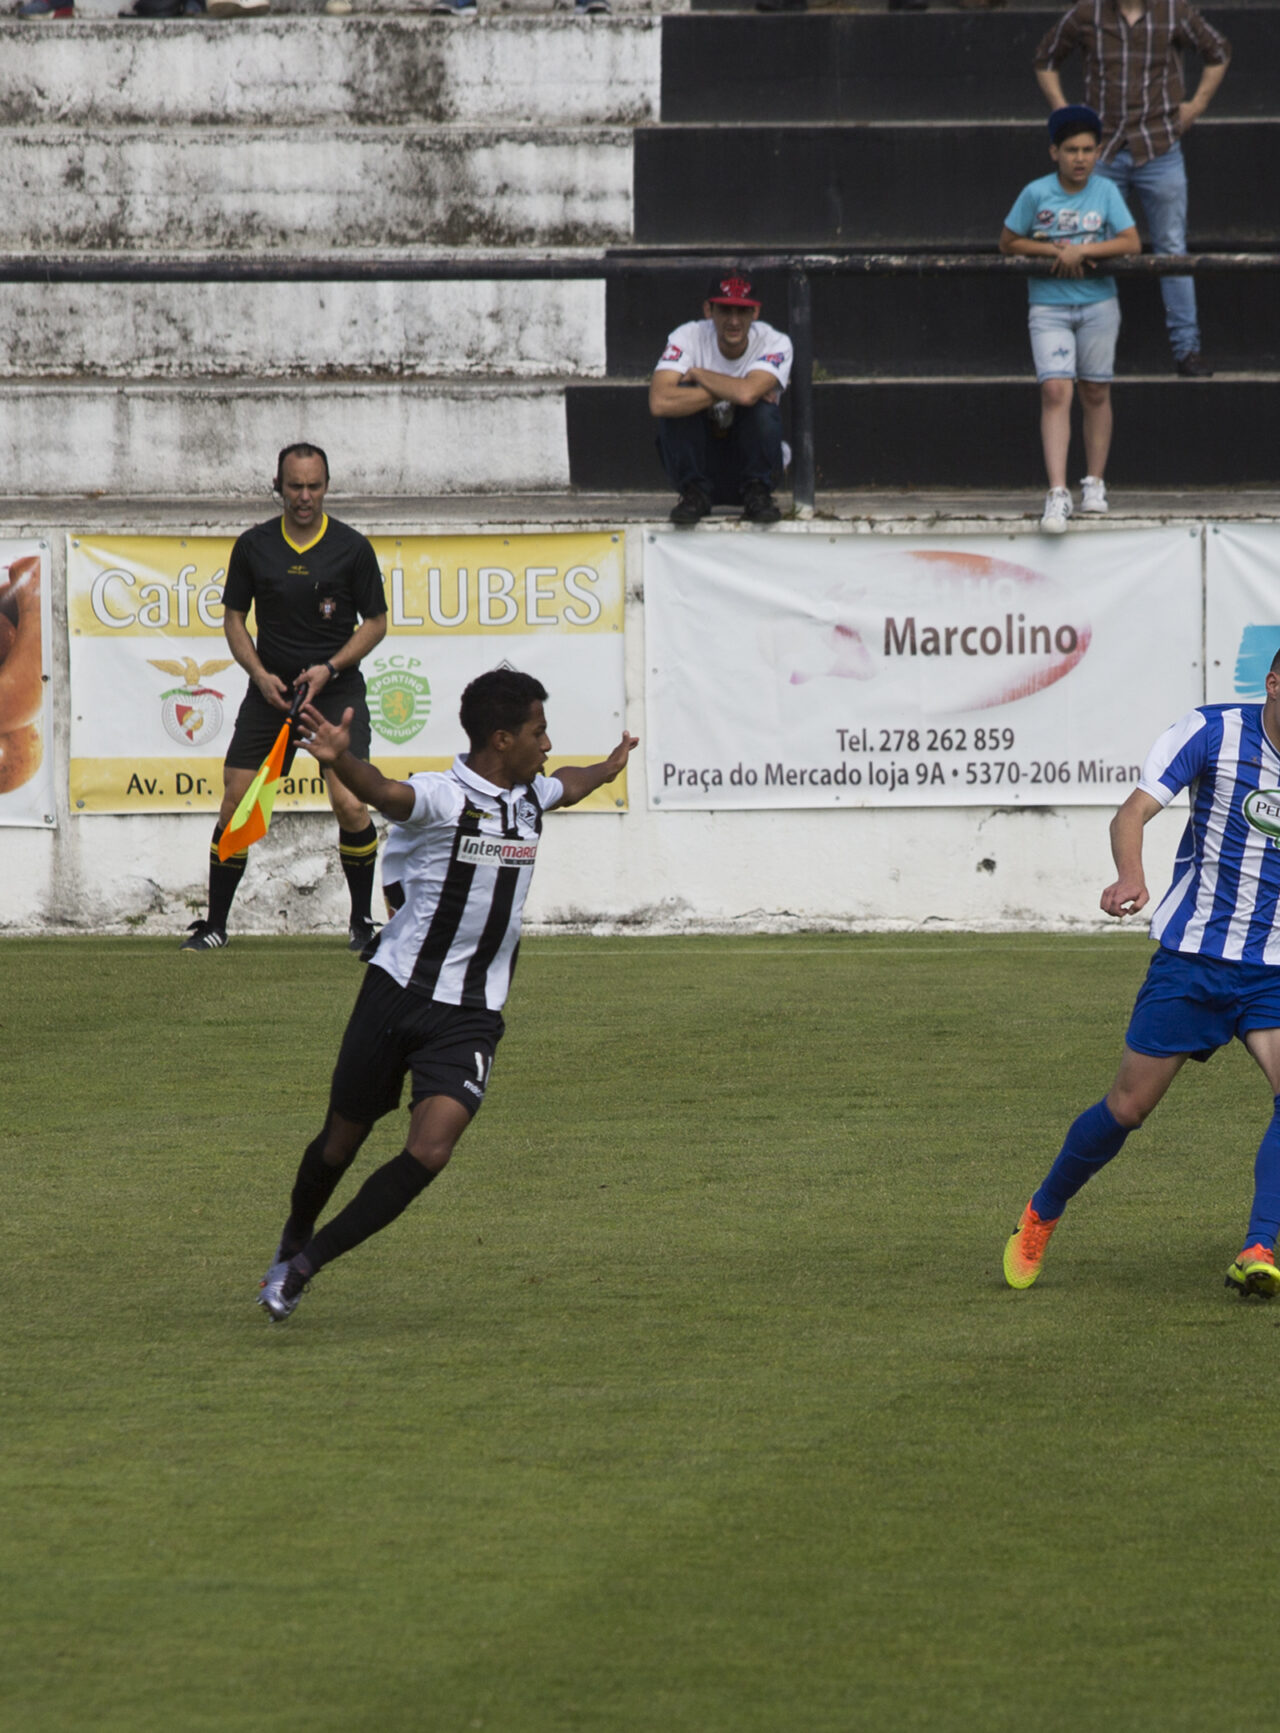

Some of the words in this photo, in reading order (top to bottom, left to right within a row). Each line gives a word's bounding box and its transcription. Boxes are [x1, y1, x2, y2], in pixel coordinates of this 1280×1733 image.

[90, 564, 223, 629] Café
[382, 564, 602, 630] LUBES
[883, 613, 1079, 657] Marcolino
[373, 654, 422, 673] SCP
[371, 674, 424, 694] SPORTING
[374, 722, 423, 737] PORTUGAL
[836, 728, 875, 752] Tel.
[879, 729, 920, 752] 278
[926, 729, 967, 751] 262
[974, 728, 1015, 751] 859
[126, 773, 164, 796] Av.
[175, 772, 213, 795] Dr.
[663, 762, 723, 793] Praça
[730, 762, 758, 786] do
[764, 761, 862, 786] Mercado
[869, 761, 909, 792] loja
[915, 762, 946, 785] 9A
[966, 761, 1072, 785] 5370-206
[1078, 760, 1142, 783] Miran
